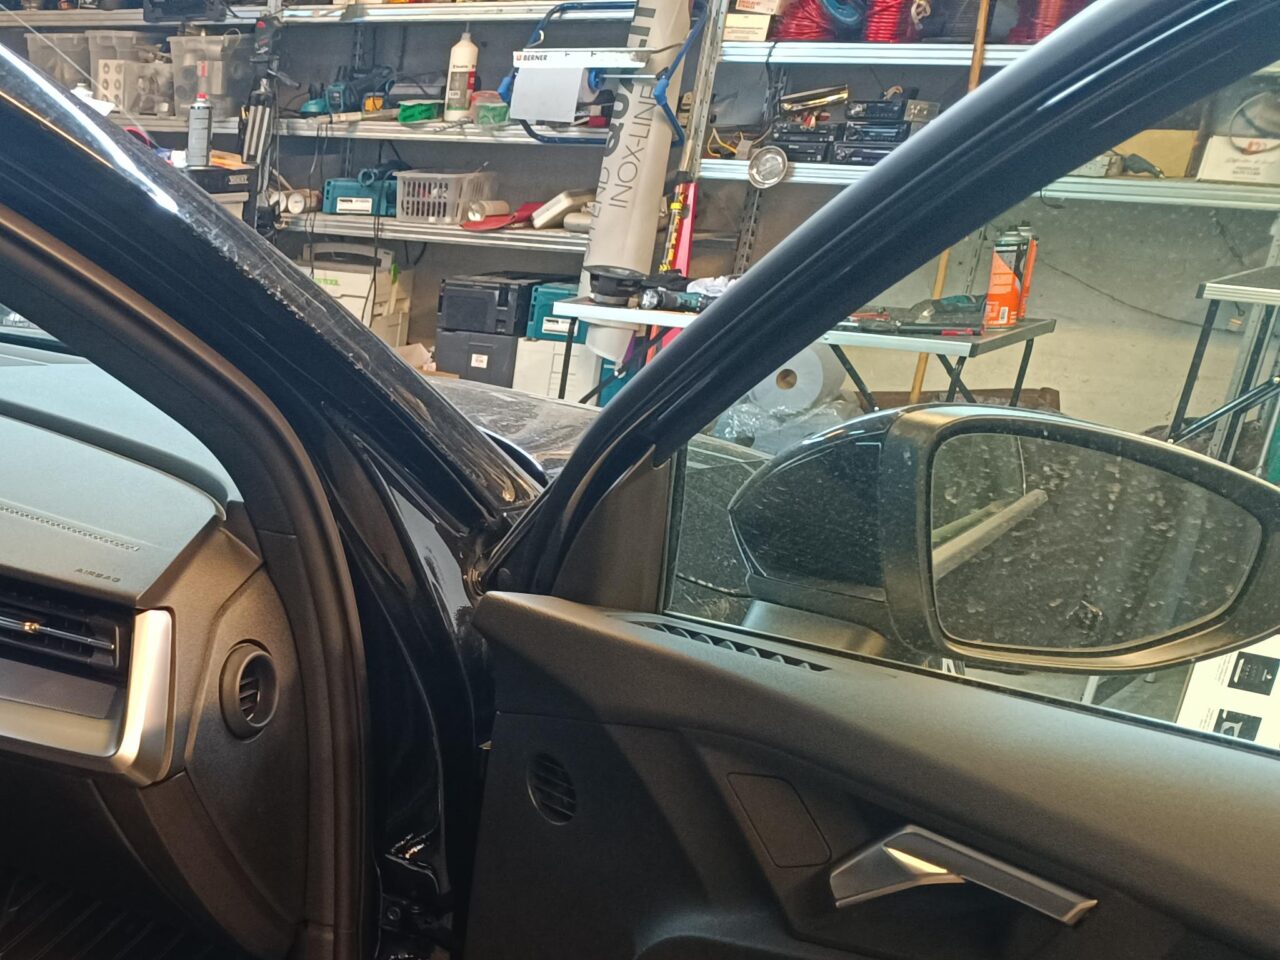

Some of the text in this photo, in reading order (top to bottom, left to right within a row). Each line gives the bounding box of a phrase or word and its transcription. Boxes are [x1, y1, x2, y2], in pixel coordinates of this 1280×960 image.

[522, 54, 548, 62] BERNER
[609, 84, 657, 209] INOX-LINE
[75, 568, 121, 583] AIRBAG
